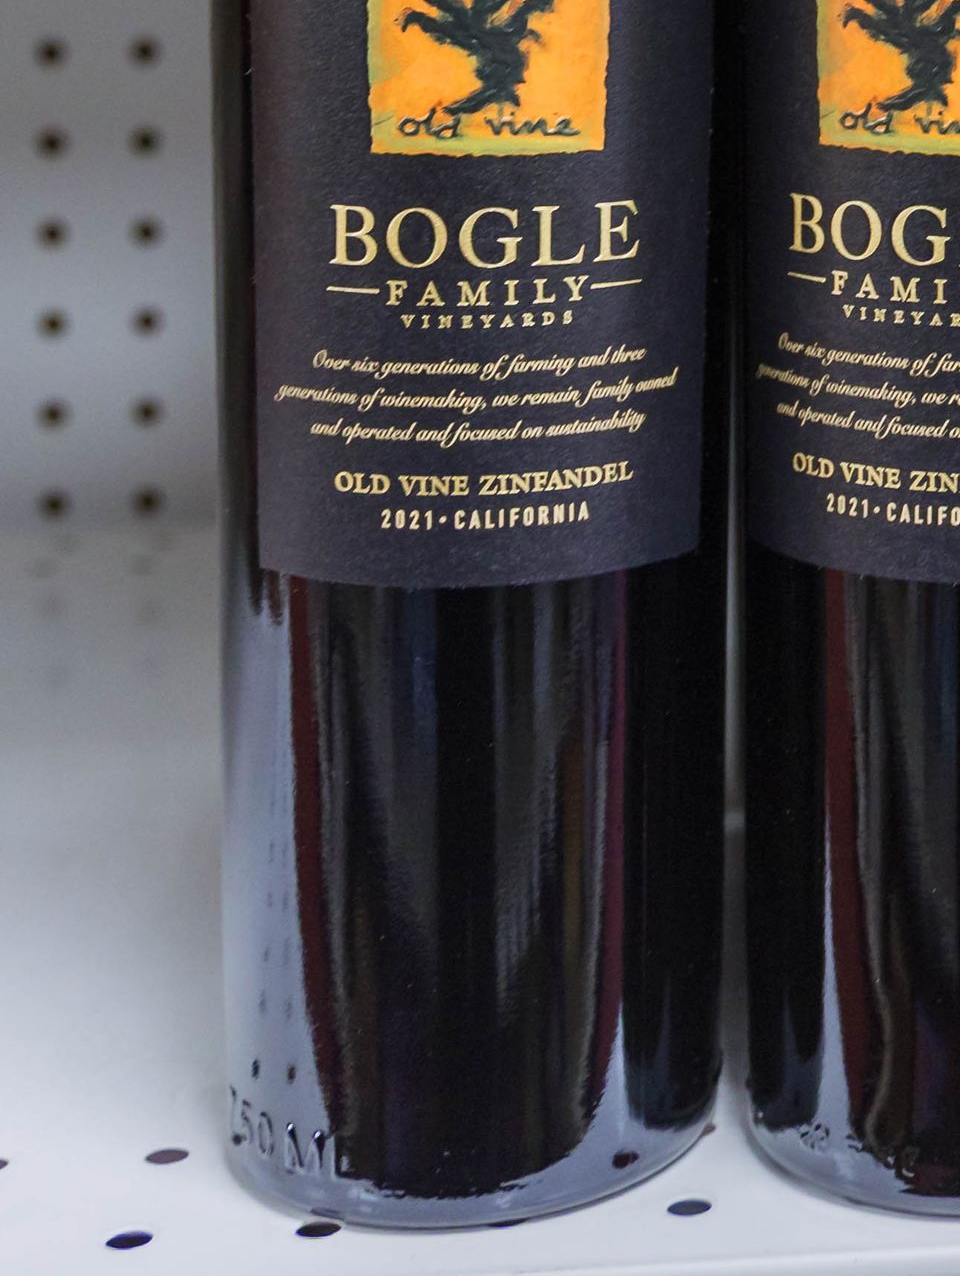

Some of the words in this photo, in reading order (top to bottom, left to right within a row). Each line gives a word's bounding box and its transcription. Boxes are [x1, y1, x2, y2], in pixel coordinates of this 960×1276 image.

[399, 109, 458, 138] old
[486, 113, 580, 137] vine
[840, 103, 893, 136] old
[329, 200, 640, 269] BOGLE
[385, 275, 589, 307] FAMILY
[401, 309, 574, 329] VINEYARDS
[312, 349, 351, 370] Over
[351, 356, 380, 372] six
[374, 358, 481, 380] generations
[480, 354, 510, 381] of
[495, 353, 576, 381] farming
[577, 346, 613, 368] and
[611, 343, 647, 364] three
[777, 332, 804, 354] Over
[805, 342, 827, 358] six
[821, 350, 911, 369] generations
[909, 352, 938, 377] of
[274, 383, 359, 405] generations
[357, 387, 386, 412] of
[380, 388, 487, 415] winemaking,
[492, 393, 521, 408] we
[520, 385, 581, 406] remain
[574, 376, 634, 408] family
[635, 366, 679, 392] owned
[809, 374, 830, 396] of
[826, 379, 917, 409] winemaking,
[921, 392, 949, 405] we
[310, 417, 344, 435] and
[342, 421, 418, 446] operated
[415, 421, 456, 442] and
[439, 420, 523, 449] focused
[521, 425, 545, 439] on
[545, 408, 647, 438] sustainability
[776, 399, 800, 419] and
[797, 405, 856, 428] operated
[854, 414, 888, 435] and
[874, 416, 950, 440] focused
[334, 470, 391, 496] OLD
[398, 475, 469, 497] VINE
[479, 461, 633, 496] ZINFANDEL
[792, 452, 835, 479] OLD
[839, 461, 902, 490] VINE
